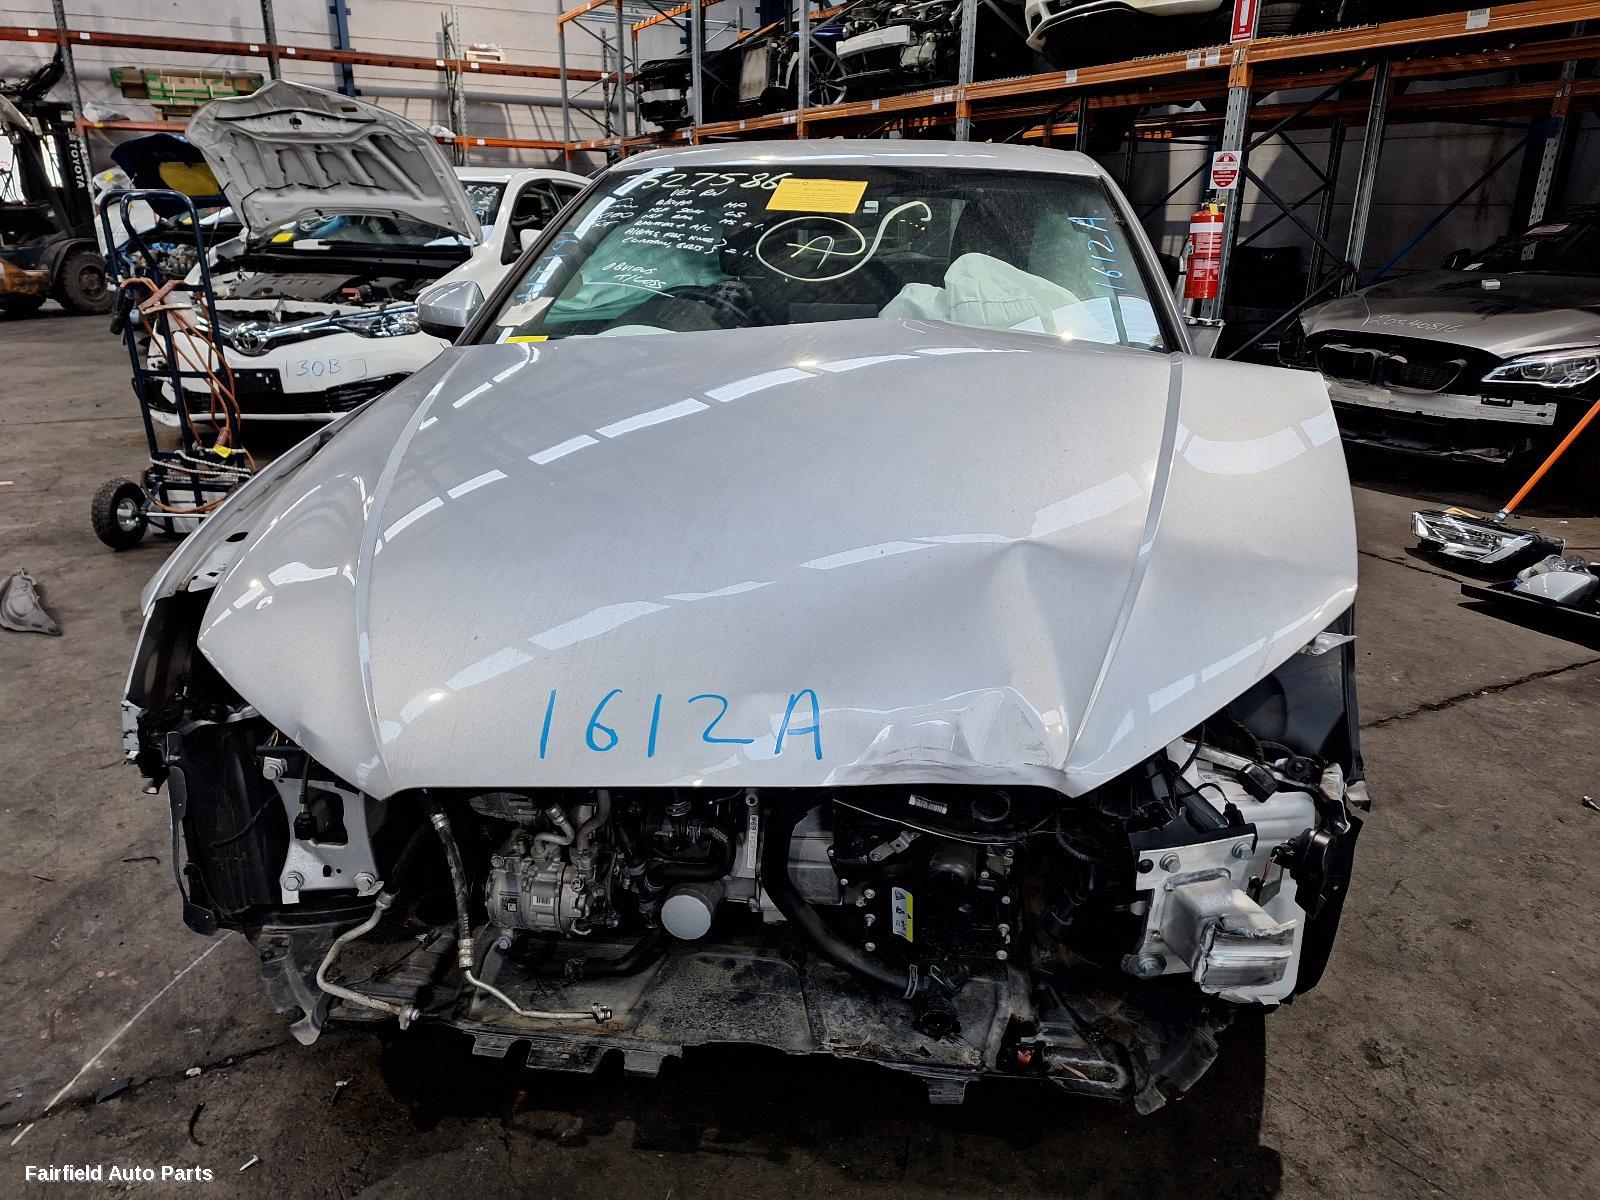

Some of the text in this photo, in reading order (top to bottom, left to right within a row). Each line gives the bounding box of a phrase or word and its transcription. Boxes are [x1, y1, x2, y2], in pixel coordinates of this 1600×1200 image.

[69, 143, 86, 189] TOYOTA
[1067, 216, 1127, 291] 1612A
[285, 358, 341, 378] 130B
[539, 688, 823, 761] 1612A
